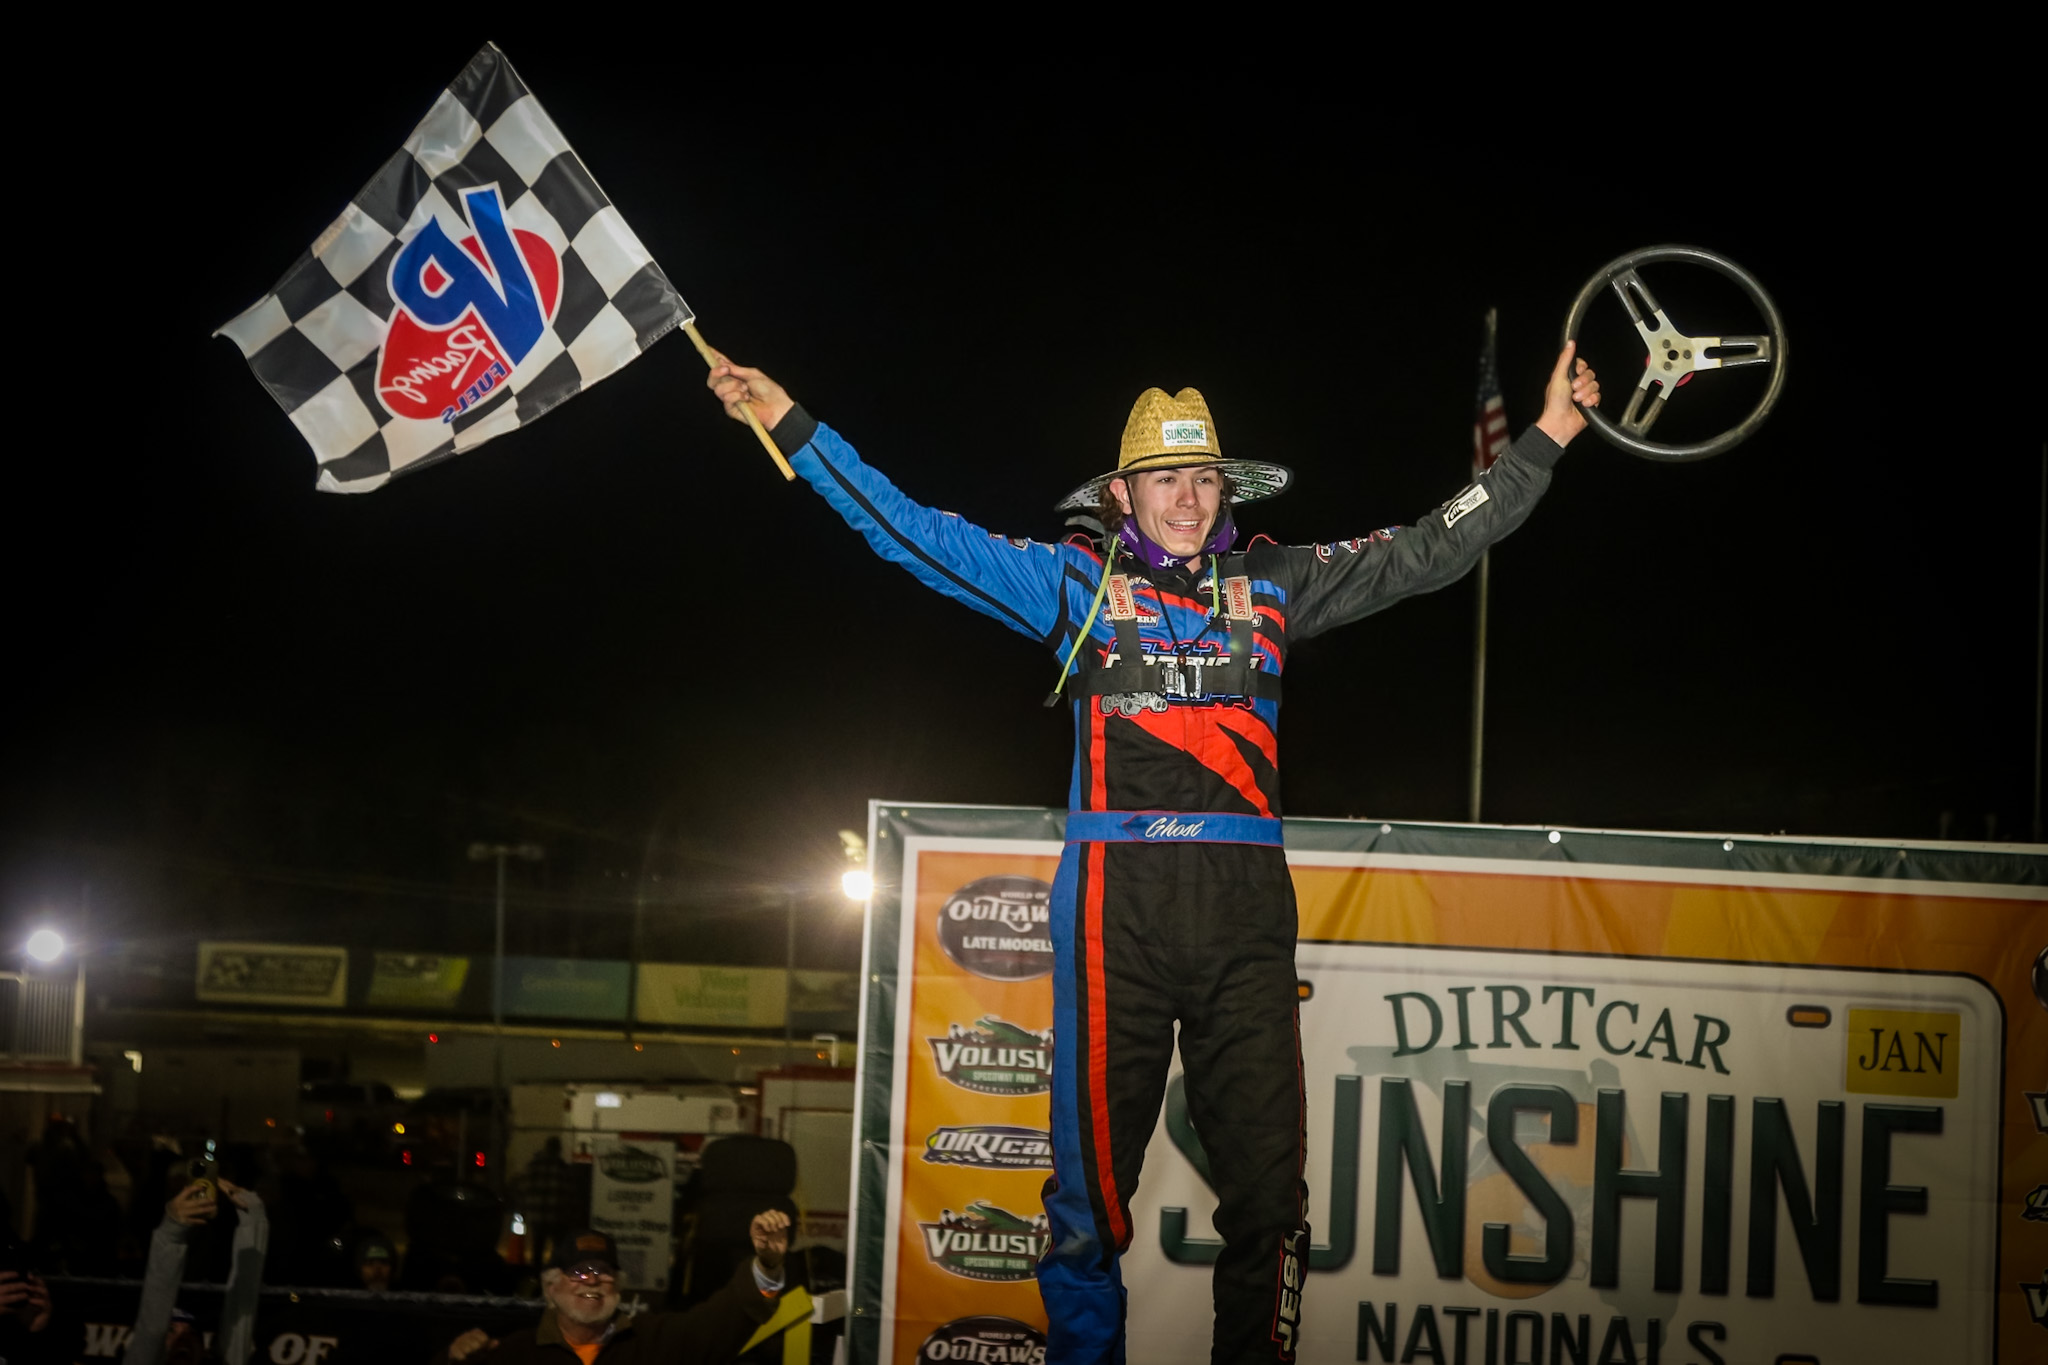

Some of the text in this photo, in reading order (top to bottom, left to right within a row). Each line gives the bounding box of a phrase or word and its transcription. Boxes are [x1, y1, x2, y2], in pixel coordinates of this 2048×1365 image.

[1164, 428, 1205, 441] SUNSHINE
[1111, 579, 1129, 615] SIMPSON
[1232, 581, 1246, 615] SIMPSON
[1145, 817, 1206, 839] Ghost
[963, 936, 997, 950] LATE
[1385, 985, 1732, 1075] DIRTCAR
[1859, 1028, 1948, 1075] JAN
[268, 1331, 339, 1365] OF
